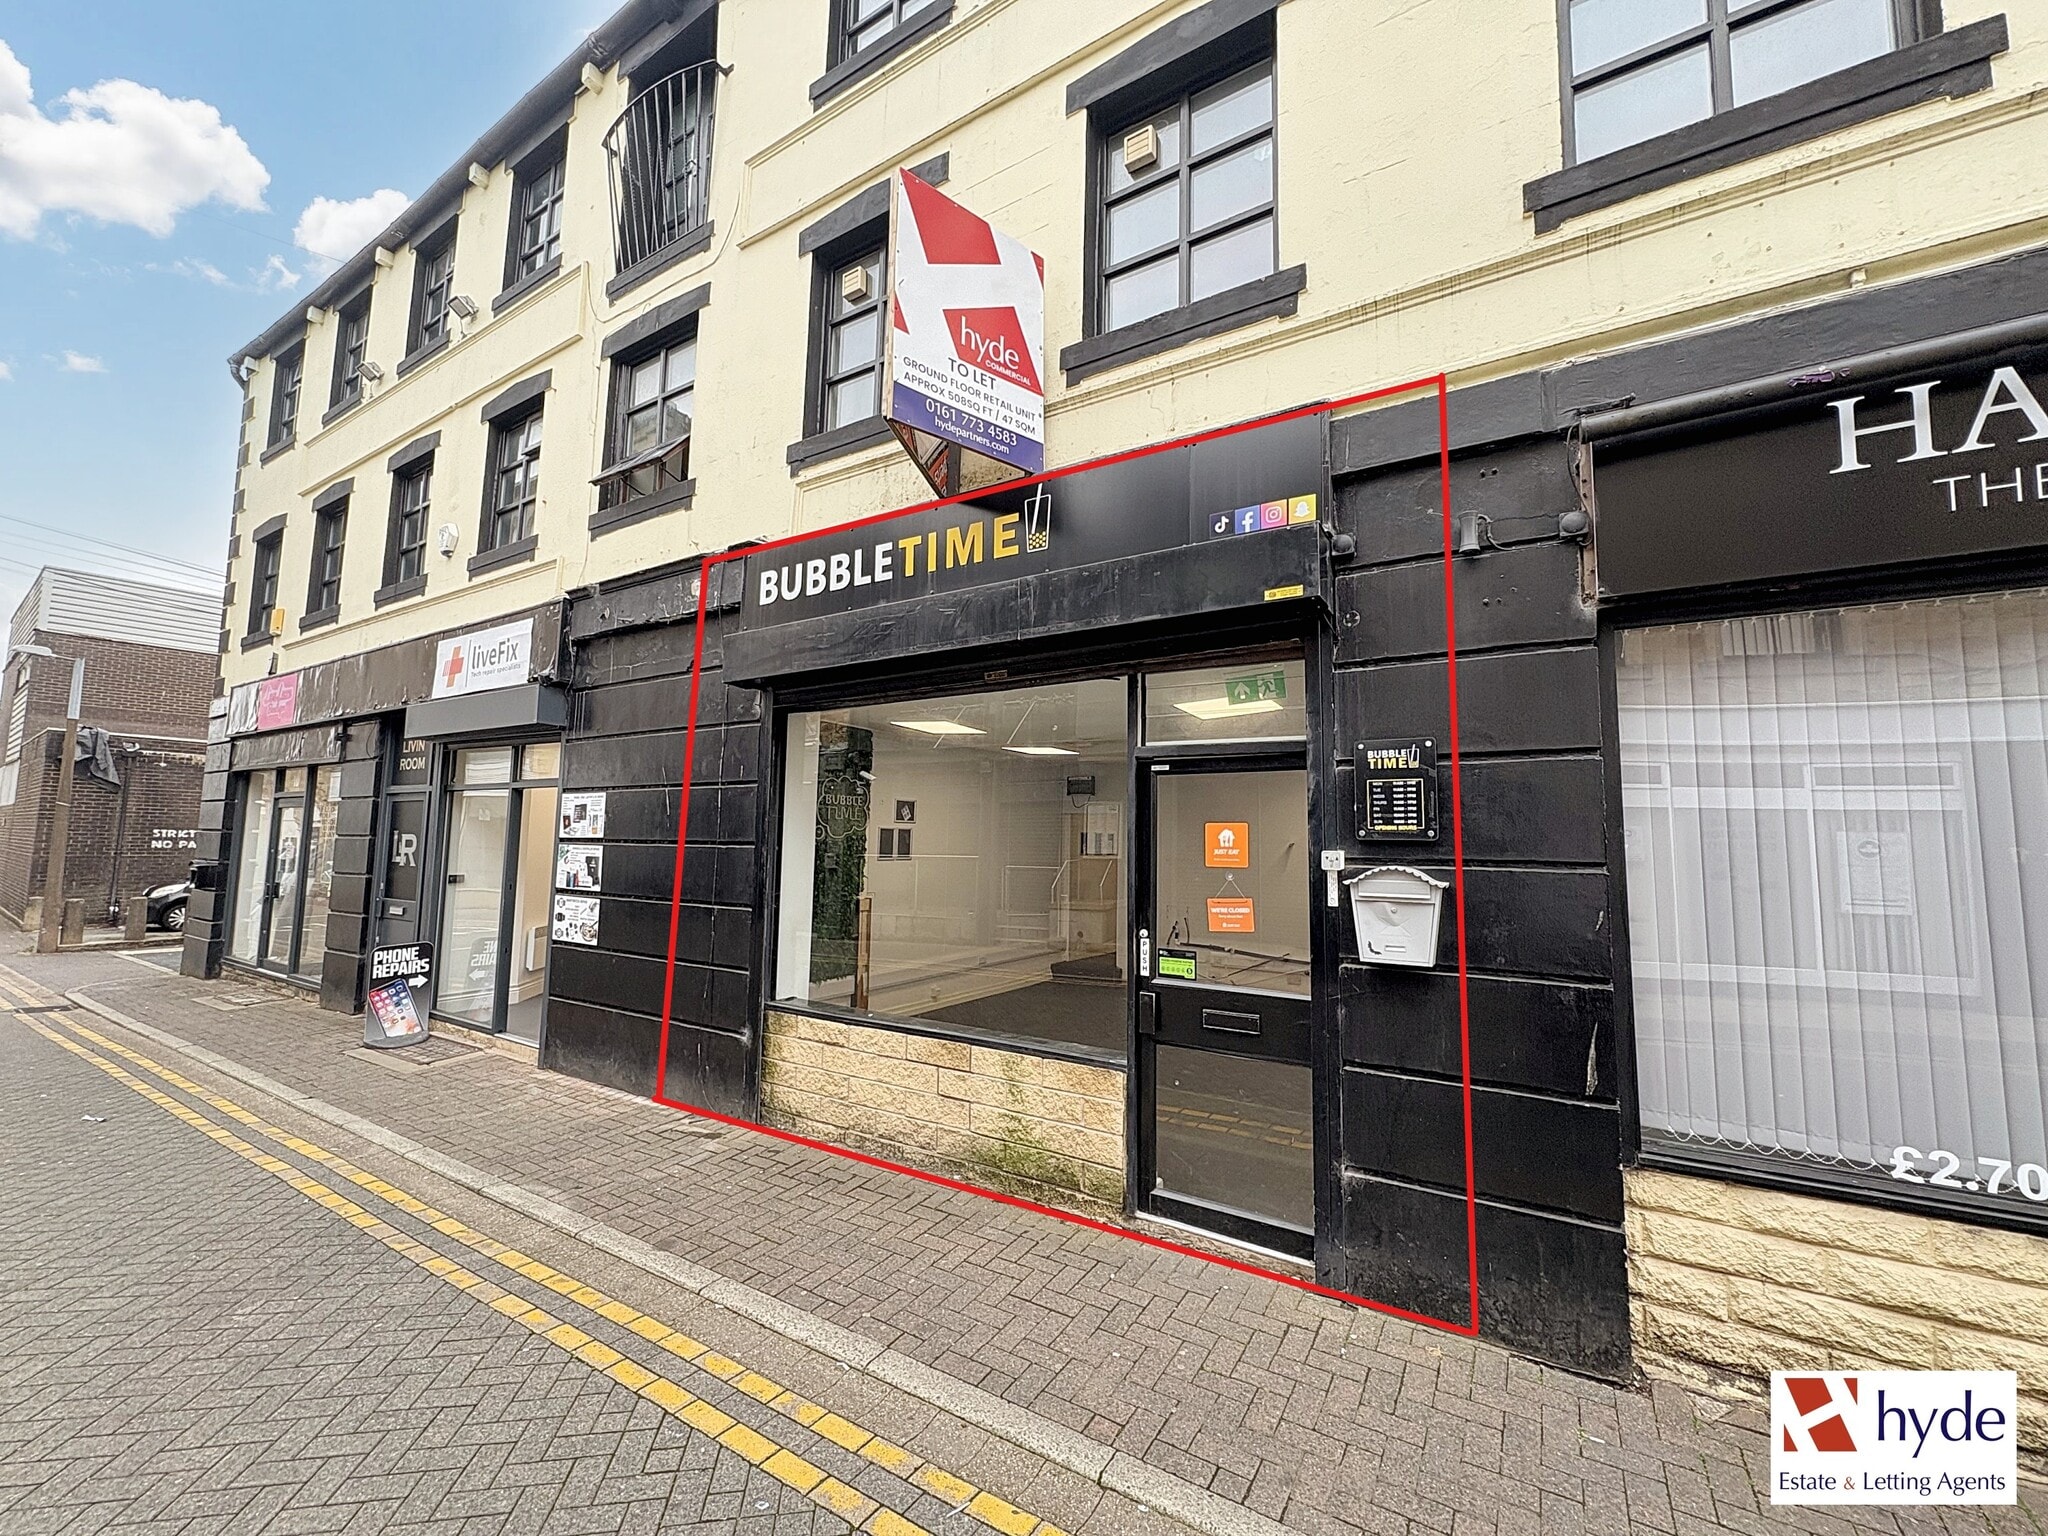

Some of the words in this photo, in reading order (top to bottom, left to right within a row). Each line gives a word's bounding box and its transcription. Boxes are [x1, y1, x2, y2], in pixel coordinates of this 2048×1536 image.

[961, 315, 1020, 370] hyde
[948, 357, 969, 377] TO
[973, 369, 996, 389] LET
[985, 359, 1031, 386] COMMERCIAL
[903, 356, 948, 383] GROUND
[950, 378, 981, 399] FLOOR
[984, 392, 1013, 413] RETAIL
[1015, 406, 1036, 422] UNIT
[904, 372, 945, 397] APPROX
[982, 406, 993, 417] FT
[1001, 414, 1013, 425] 47
[1015, 418, 1036, 435] SQM
[925, 399, 957, 421] 0161
[961, 413, 984, 433] 773
[987, 425, 1017, 446] 4583
[934, 416, 1010, 454] hydepartners.com
[1826, 366, 2048, 475] HA
[472, 637, 519, 670] liveFix
[400, 757, 426, 771] ROOM
[1367, 749, 1407, 759] BUBBLE
[1367, 757, 1407, 769] TIME
[825, 794, 864, 806] BUBBLE
[151, 840, 173, 849] NO
[372, 958, 430, 979] REPAIRS
[373, 946, 420, 965] PHONE
